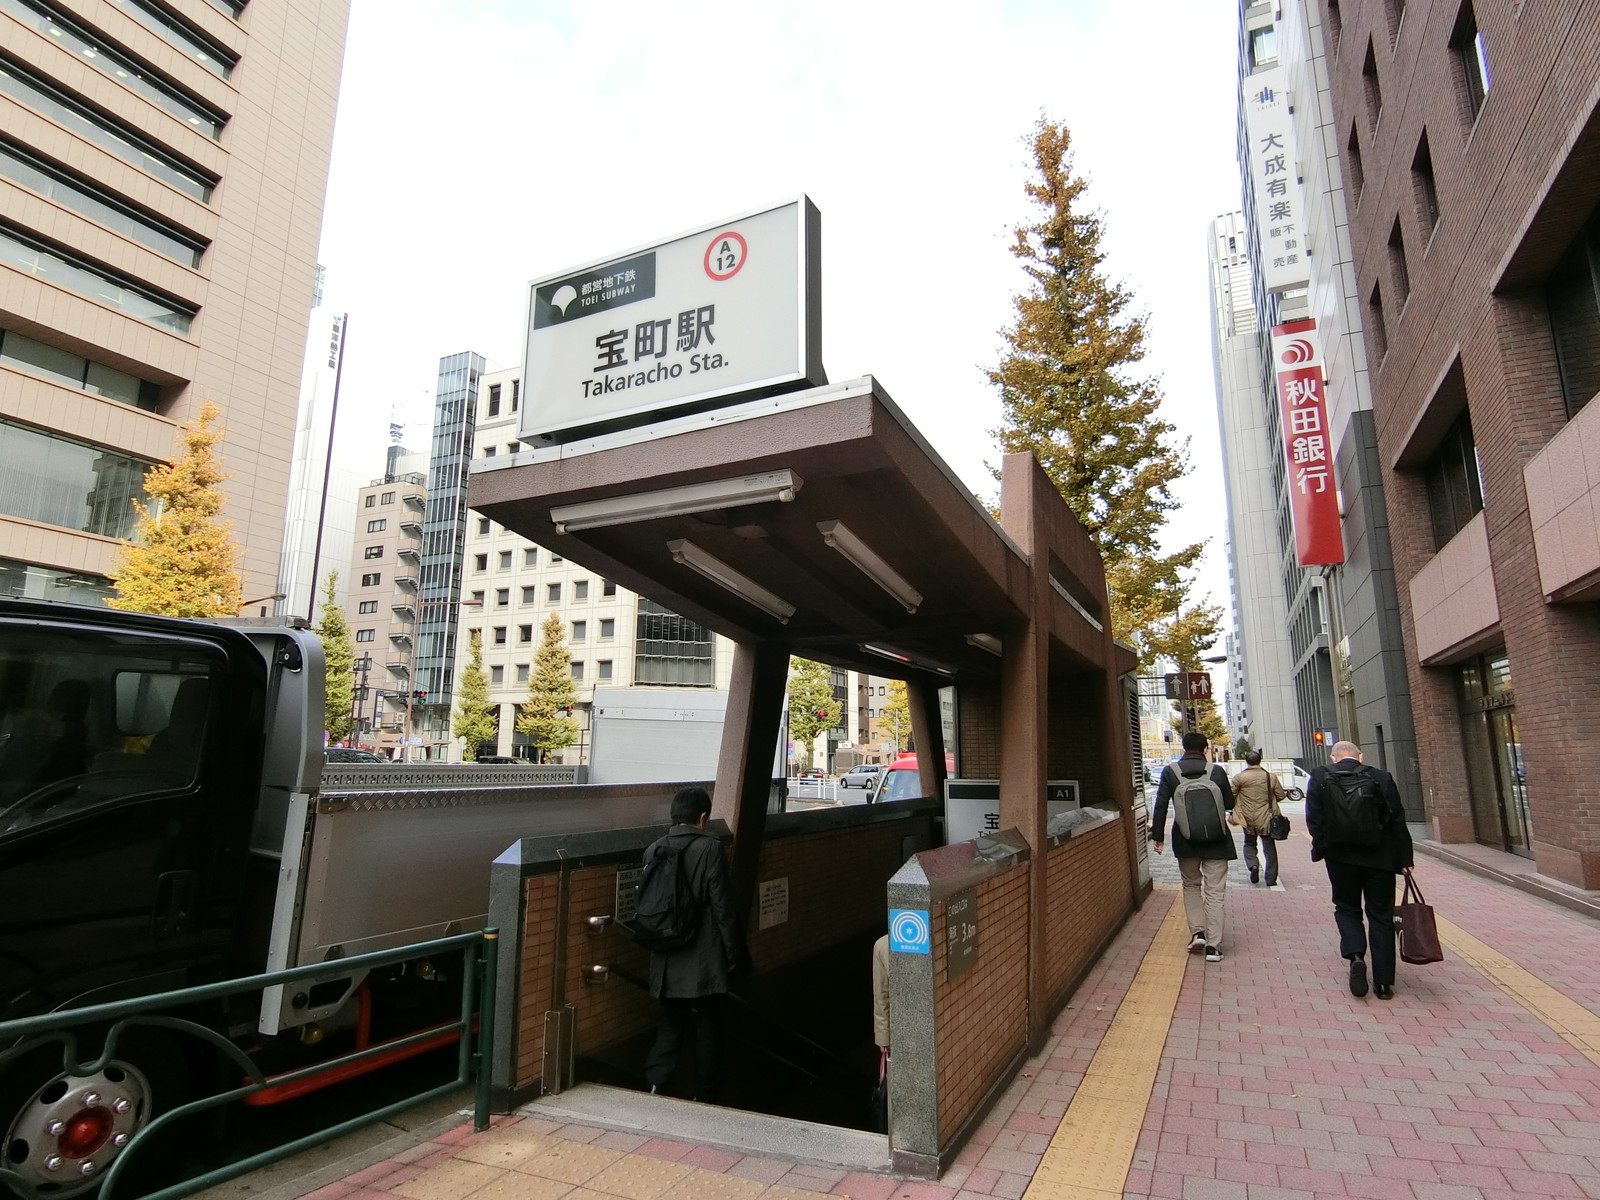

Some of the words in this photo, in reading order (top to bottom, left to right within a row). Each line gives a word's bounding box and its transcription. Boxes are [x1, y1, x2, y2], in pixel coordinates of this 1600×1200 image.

[1261, 133, 1292, 222] 大成有楽
[720, 240, 731, 255] A
[1283, 224, 1299, 265] 不動産
[717, 254, 736, 271] 12
[581, 269, 636, 296] 都営地下鉄
[581, 295, 598, 307] TOEI
[601, 284, 636, 301] SUBWAY
[593, 304, 715, 373] 宝町駅
[581, 361, 683, 399] Takaracho
[689, 351, 729, 375] Sta.
[1285, 378, 1328, 494] 秋田銀行
[1056, 789, 1069, 798] A1
